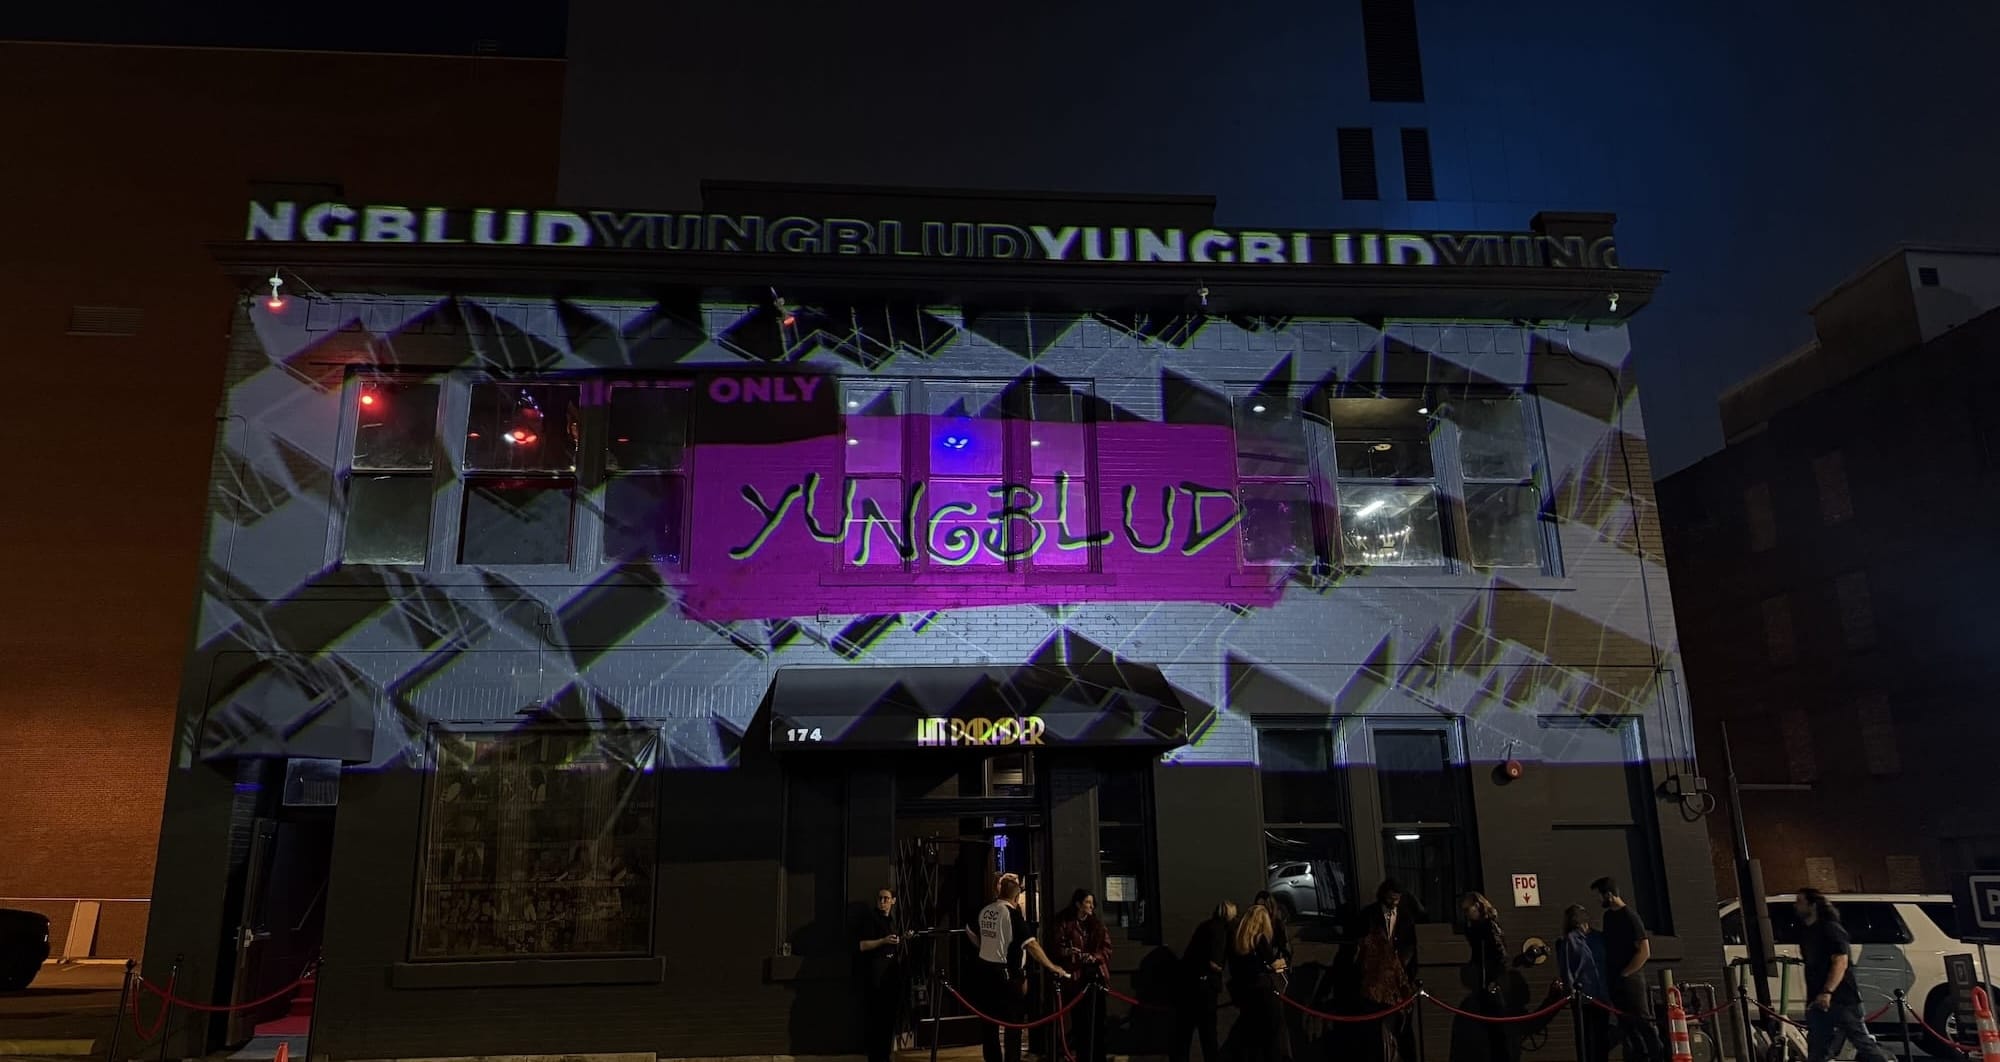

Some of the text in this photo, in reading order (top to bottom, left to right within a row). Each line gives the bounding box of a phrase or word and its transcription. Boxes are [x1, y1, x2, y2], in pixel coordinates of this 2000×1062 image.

[588, 210, 1033, 258] YUNGBLUD
[708, 375, 822, 404] ONLY
[728, 470, 1248, 567] YUNGBLUD
[787, 728, 822, 742] 174
[917, 716, 1046, 746] HIT PARADER
[1514, 876, 1536, 889] FDC
